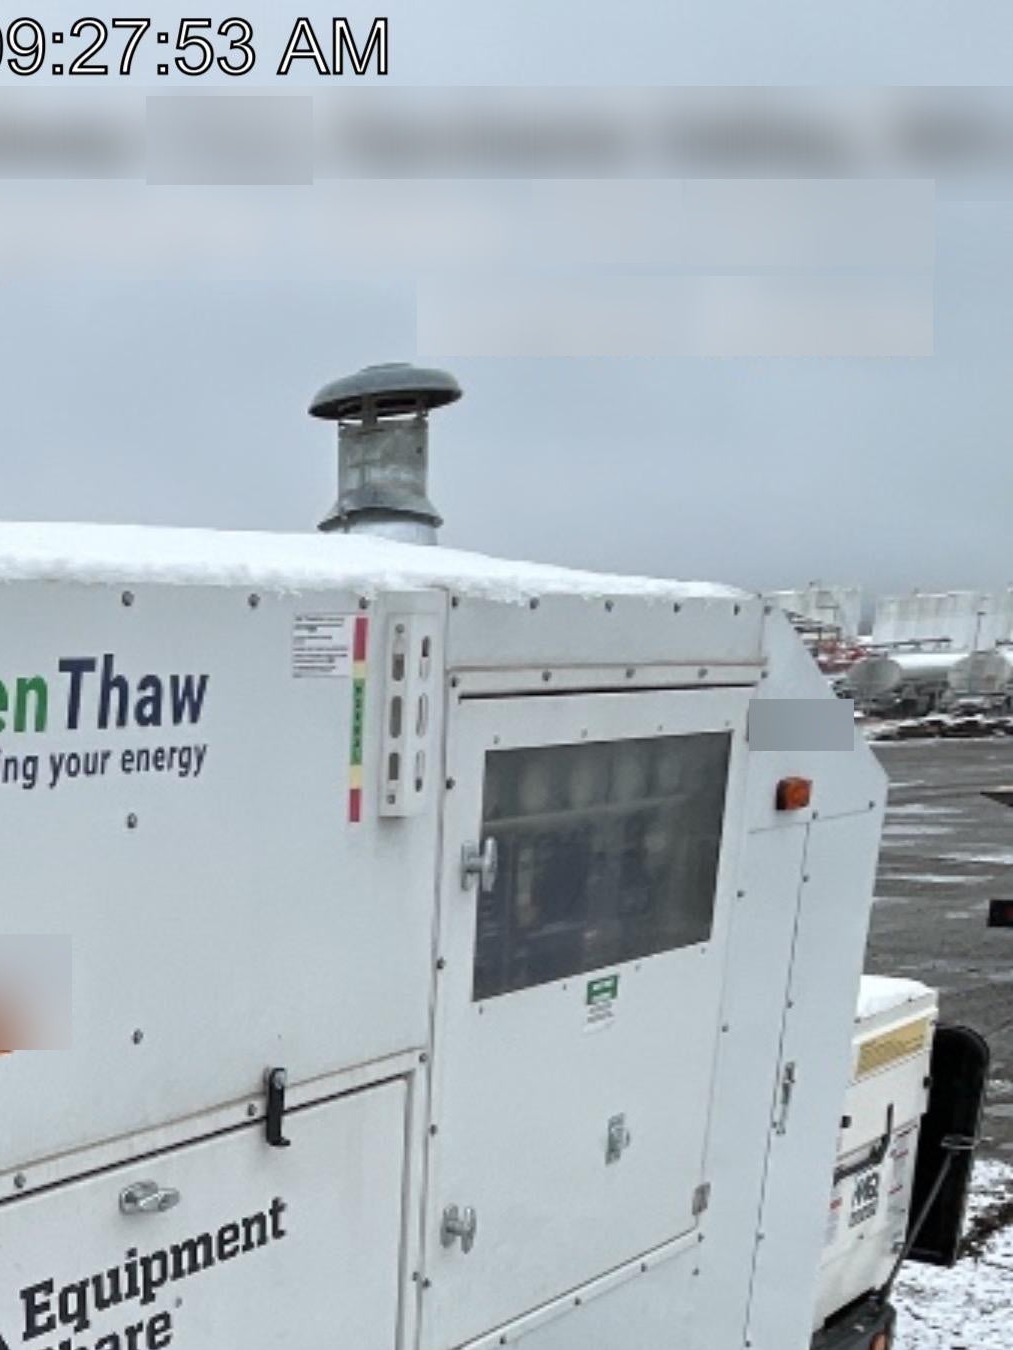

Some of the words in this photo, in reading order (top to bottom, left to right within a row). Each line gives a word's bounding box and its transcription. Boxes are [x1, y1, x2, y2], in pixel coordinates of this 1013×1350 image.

[48, 748, 112, 789] your
[120, 743, 209, 778] energy
[20, 1196, 286, 1341] Equipment
